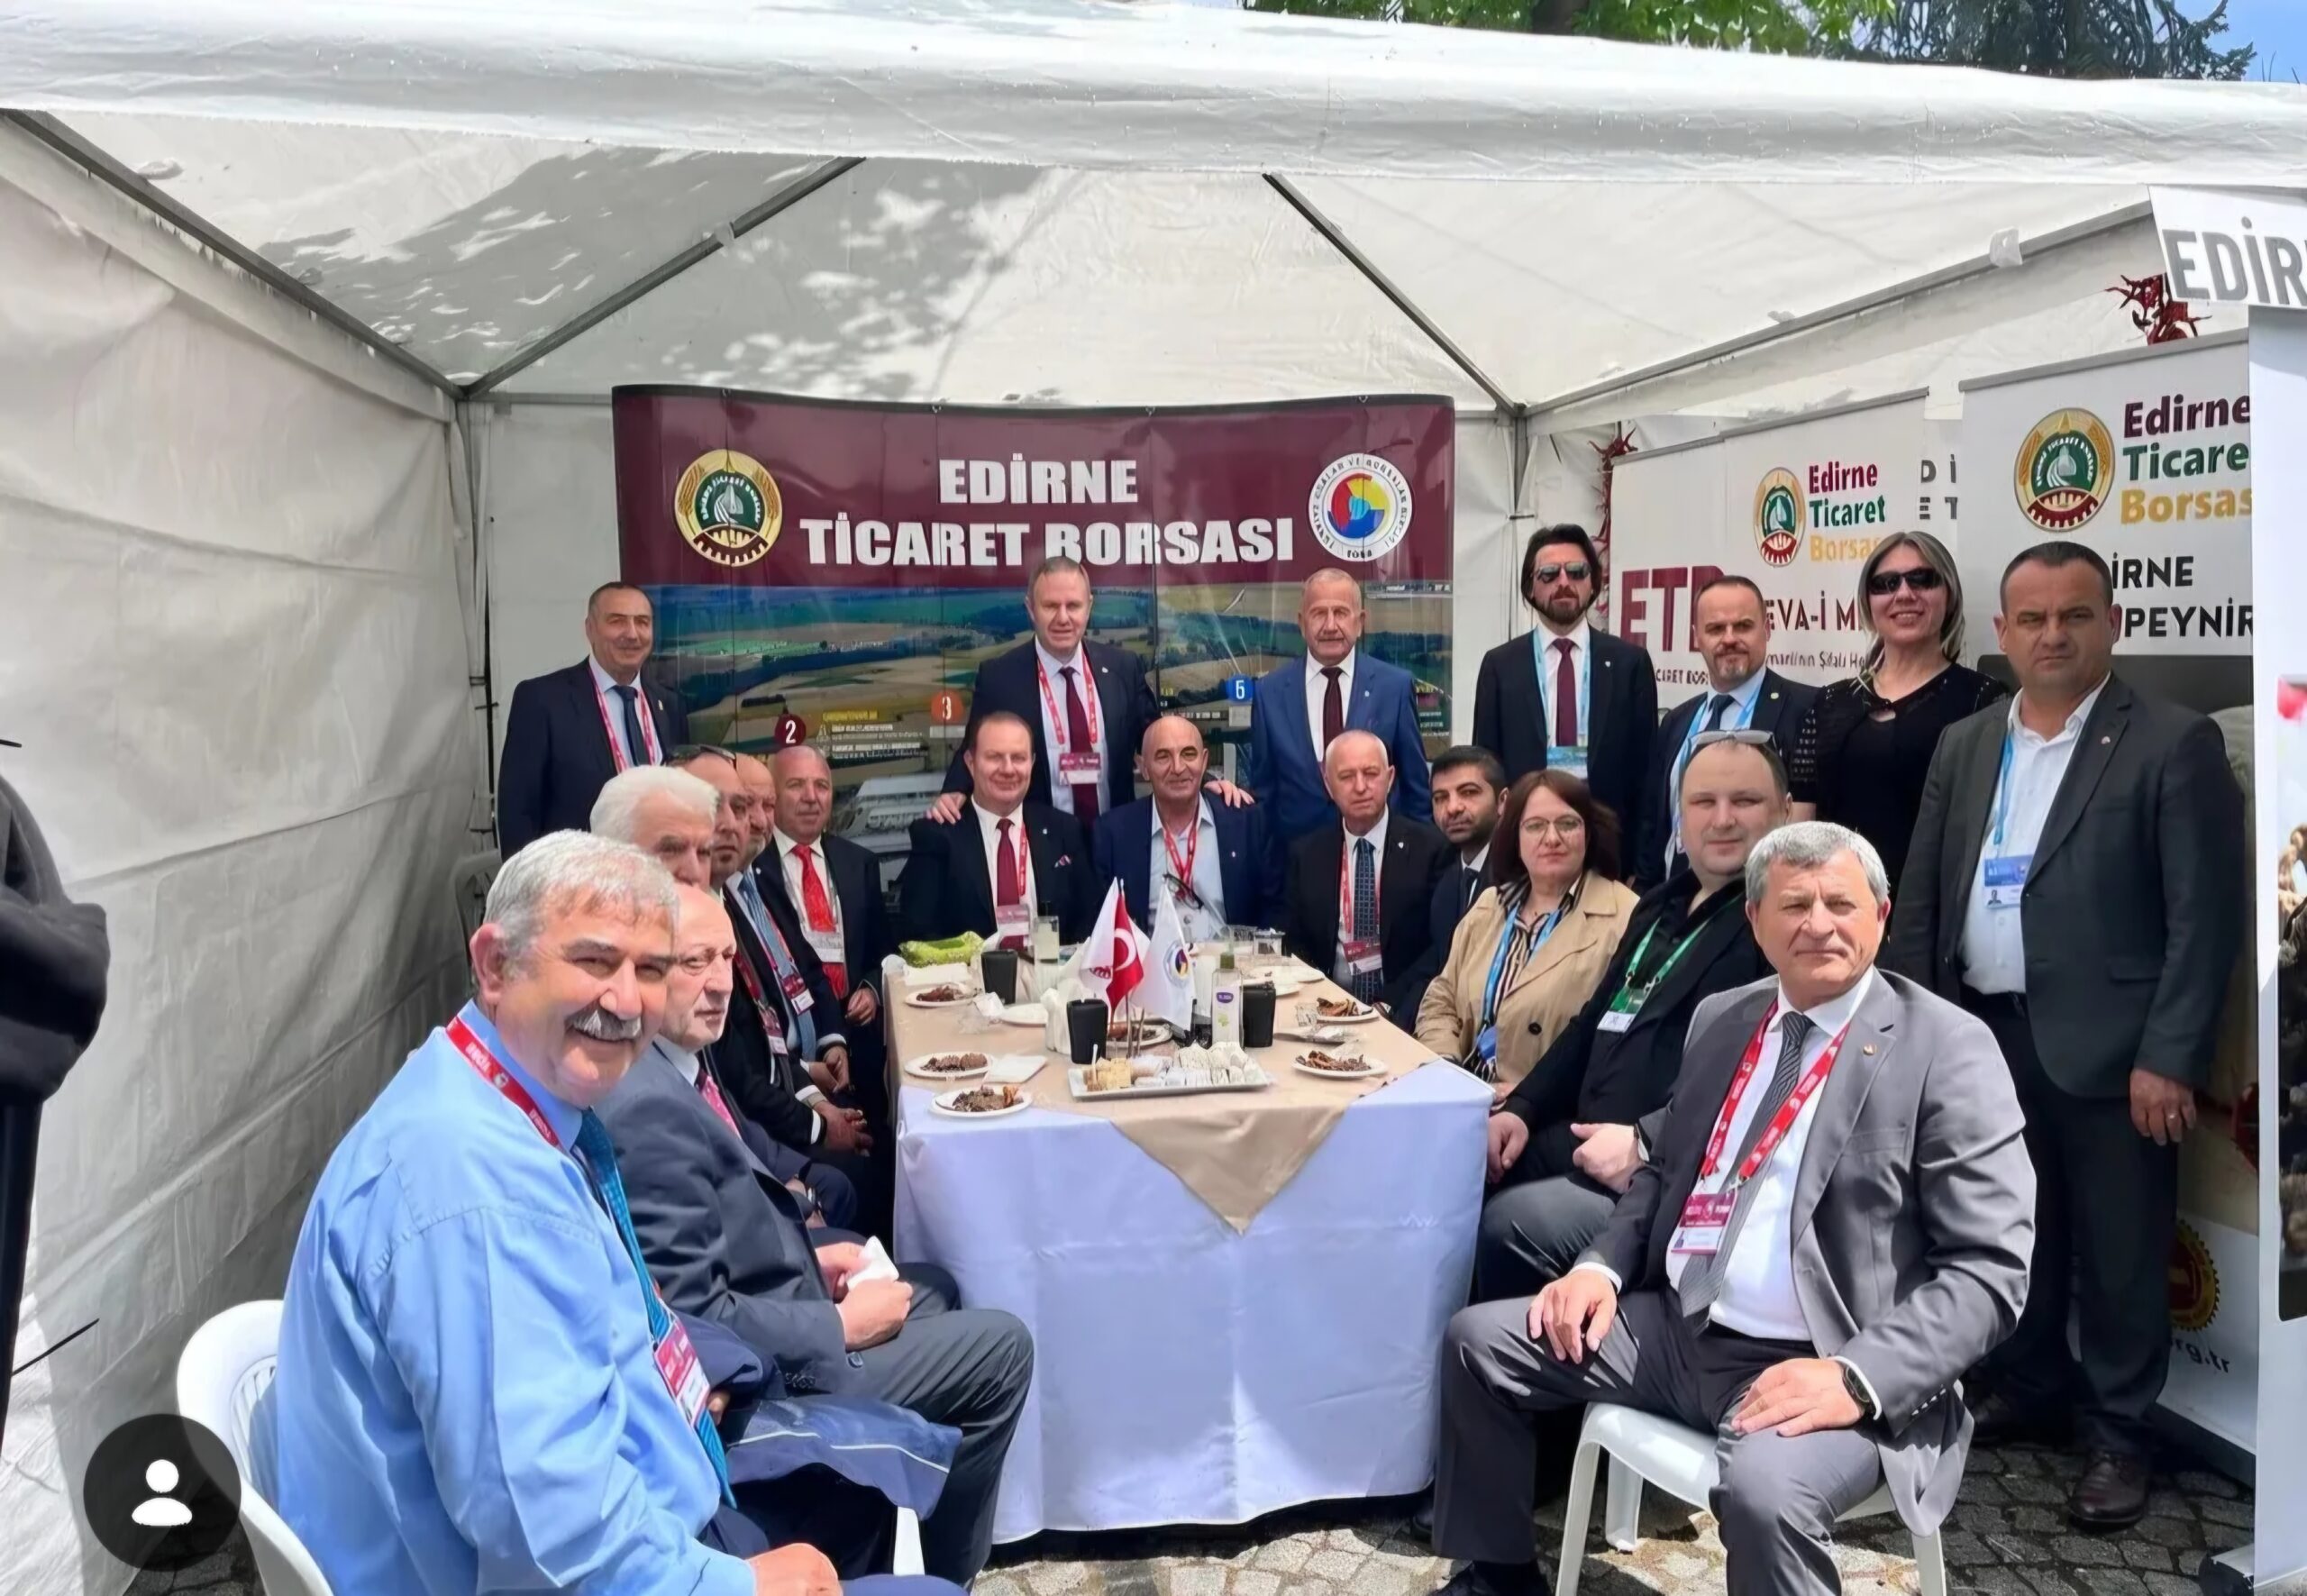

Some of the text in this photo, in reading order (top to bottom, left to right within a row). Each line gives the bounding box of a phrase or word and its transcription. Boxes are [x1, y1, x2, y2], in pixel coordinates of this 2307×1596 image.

[2162, 216, 2307, 306] EDİR
[2124, 394, 2251, 439] Edirne
[938, 452, 1139, 505] EDİRNE
[1809, 461, 1878, 495] Edirne
[2122, 442, 2250, 481] Ticare
[1809, 494, 1886, 529] Ticaret
[799, 511, 1031, 567] TİCARET
[1044, 517, 1294, 567] BORSASI
[2111, 552, 2194, 589] İRNE
[2124, 597, 2253, 638] PEYNİR
[942, 696, 952, 720] 3
[785, 719, 797, 744] 2
[2170, 1337, 2230, 1374] rg.tr
